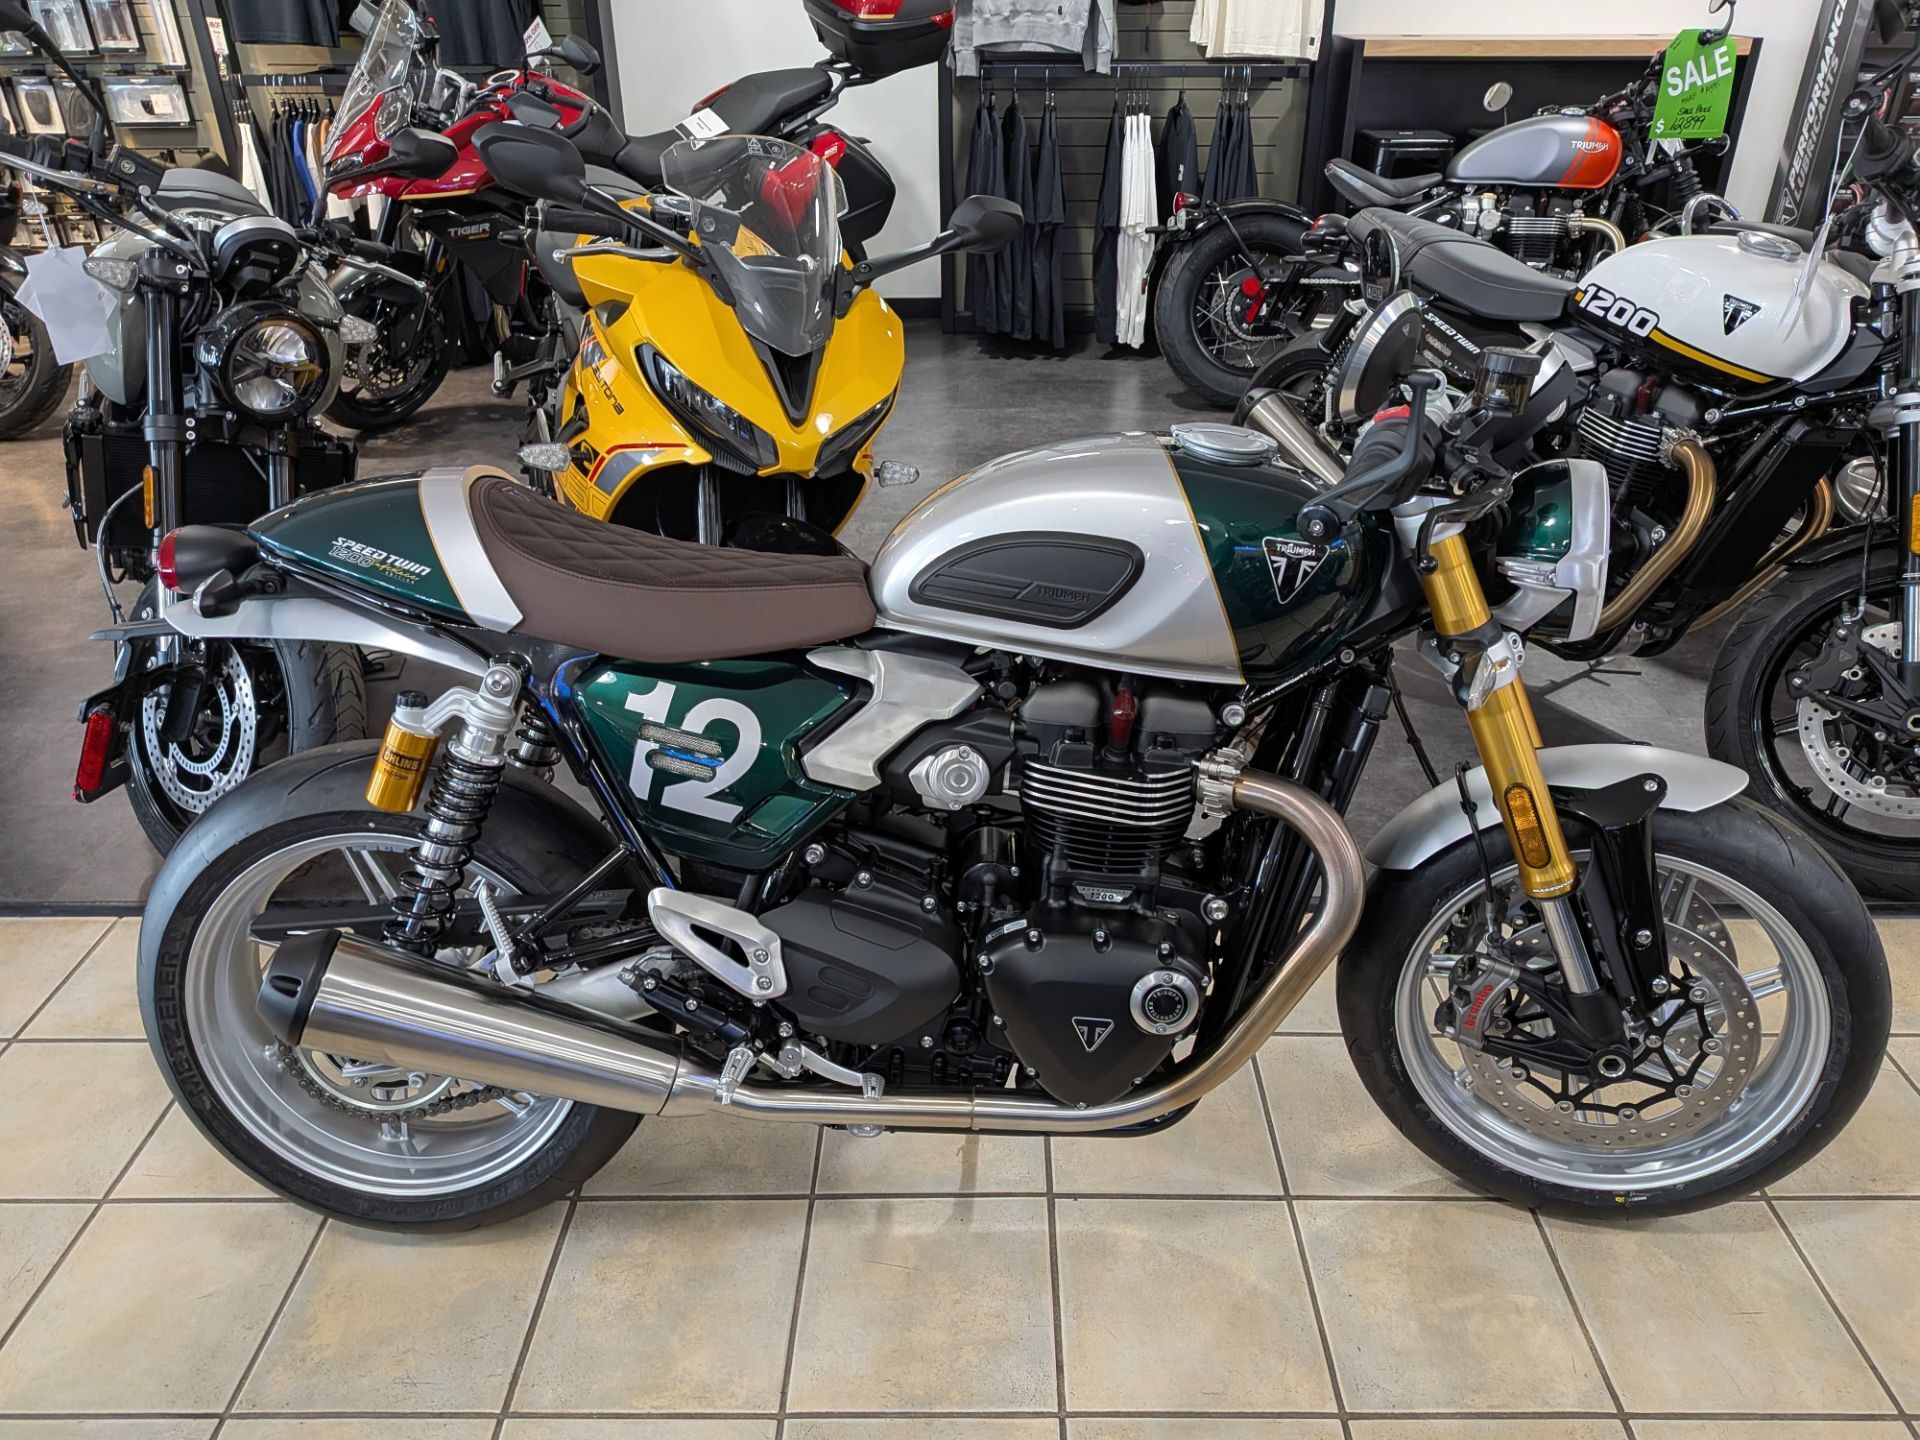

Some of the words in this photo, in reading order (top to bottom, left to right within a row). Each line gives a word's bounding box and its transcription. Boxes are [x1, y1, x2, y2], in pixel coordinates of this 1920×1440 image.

[1666, 45, 1732, 97] SALE
[1570, 140, 1609, 151] TRIUMPH
[1655, 118, 1664, 134] $
[1793, 52, 1838, 202] LUBRICANTS
[448, 222, 490, 237] TIGER
[1578, 285, 1658, 338] 1200
[1424, 312, 1458, 336] SPEED
[1453, 332, 1481, 355] TWIN
[328, 545, 374, 567] 1200
[331, 536, 388, 560] SPEED
[386, 554, 432, 576] TWIN
[1276, 543, 1316, 557] TRIUMPH
[1038, 586, 1089, 602] TRIUMPH
[624, 680, 762, 824] 12
[1090, 892, 1115, 901] 1200
[157, 947, 206, 1100] METZELER
[1462, 984, 1493, 1029] brembo
